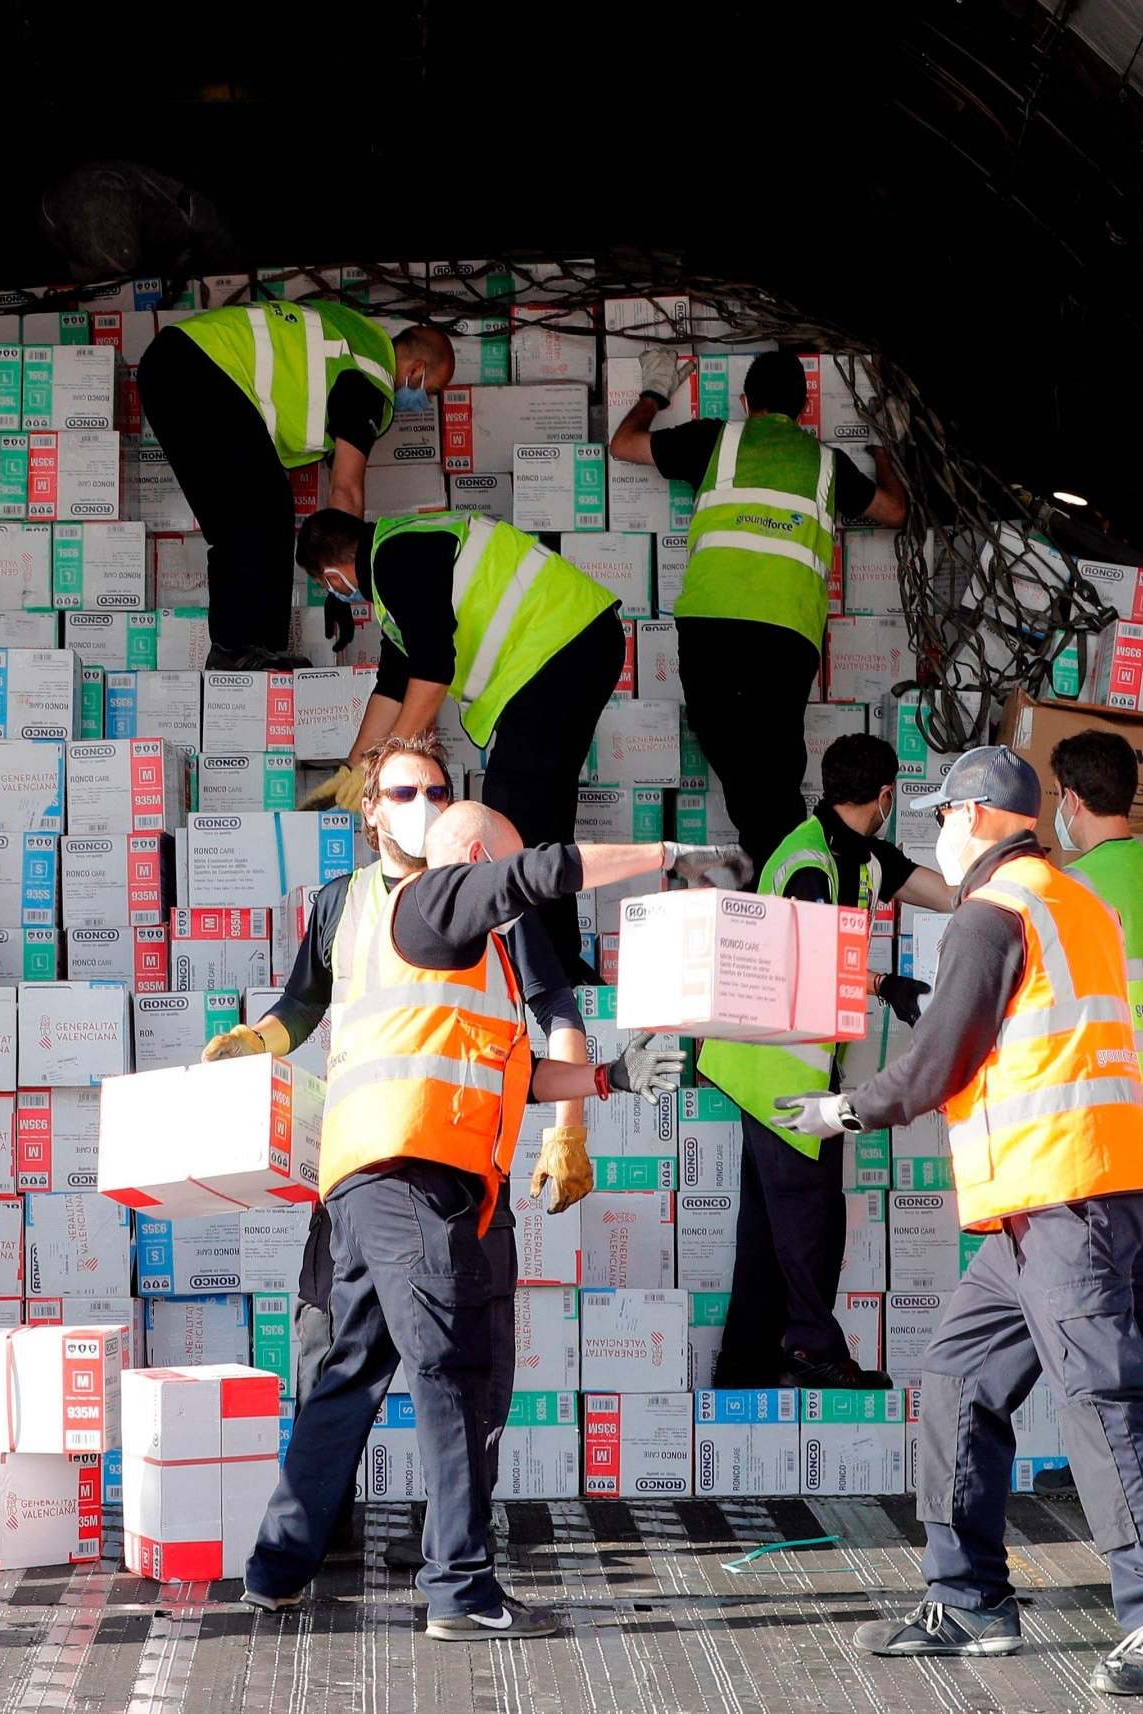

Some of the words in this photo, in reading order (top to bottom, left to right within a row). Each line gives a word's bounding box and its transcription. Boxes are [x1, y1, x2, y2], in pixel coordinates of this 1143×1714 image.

[69, 418, 106, 428] RONCO
[445, 412, 469, 423] 935M
[520, 448, 557, 458] RONCO
[30, 456, 55, 467] 935M
[458, 477, 494, 487] RONCO
[74, 504, 112, 514] RONCO
[735, 512, 793, 532] groundforce
[580, 562, 634, 572] GENERALITAT
[1085, 566, 1121, 579] RONCO
[99, 596, 137, 606] RONCO
[1116, 645, 1142, 659] 935M
[834, 654, 887, 663] VALENCIANA
[212, 676, 250, 685] RONCO
[1120, 671, 1131, 682] M
[25, 727, 64, 737] RONCO
[73, 746, 113, 756] RONCO
[207, 758, 246, 768] RONCO
[0, 772, 59, 784] GENERALITAT
[2, 782, 58, 792] VALENCIANA
[134, 794, 161, 806] 935M
[198, 819, 238, 827] RONCO
[70, 841, 109, 852] RONCO
[26, 889, 51, 900] 935S
[131, 890, 158, 901] 935M
[725, 901, 763, 917] RONCO
[230, 910, 241, 936] 935M
[76, 930, 116, 941] RONCO
[720, 937, 745, 950] RONCO
[137, 981, 164, 993] 935M
[142, 999, 185, 1009] RONCO
[55, 1022, 118, 1033] GENERALITAT
[56, 1031, 118, 1041] VALENCIANA
[19, 1118, 48, 1129] 935M
[687, 1141, 697, 1182] RONCO
[686, 1198, 727, 1208] RONCO
[898, 1197, 939, 1207] RONCO
[244, 1226, 271, 1235] RONCO
[522, 1215, 531, 1277] VALENCIANA
[534, 1213, 543, 1279] GENERALITAT
[194, 1277, 236, 1286] RONCO
[894, 1296, 937, 1307] RONCO
[585, 1338, 646, 1347] VALENCIANA
[584, 1348, 647, 1359] GENERALITAT
[77, 1375, 89, 1388] M
[67, 1406, 99, 1420] 935M
[588, 1423, 617, 1435] 935M
[376, 1449, 384, 1492] RONCO
[702, 1443, 712, 1487] RONCO
[808, 1443, 818, 1487] RONCO
[639, 1479, 682, 1491] RONCO
[21, 1507, 77, 1520] VALENCIANA
